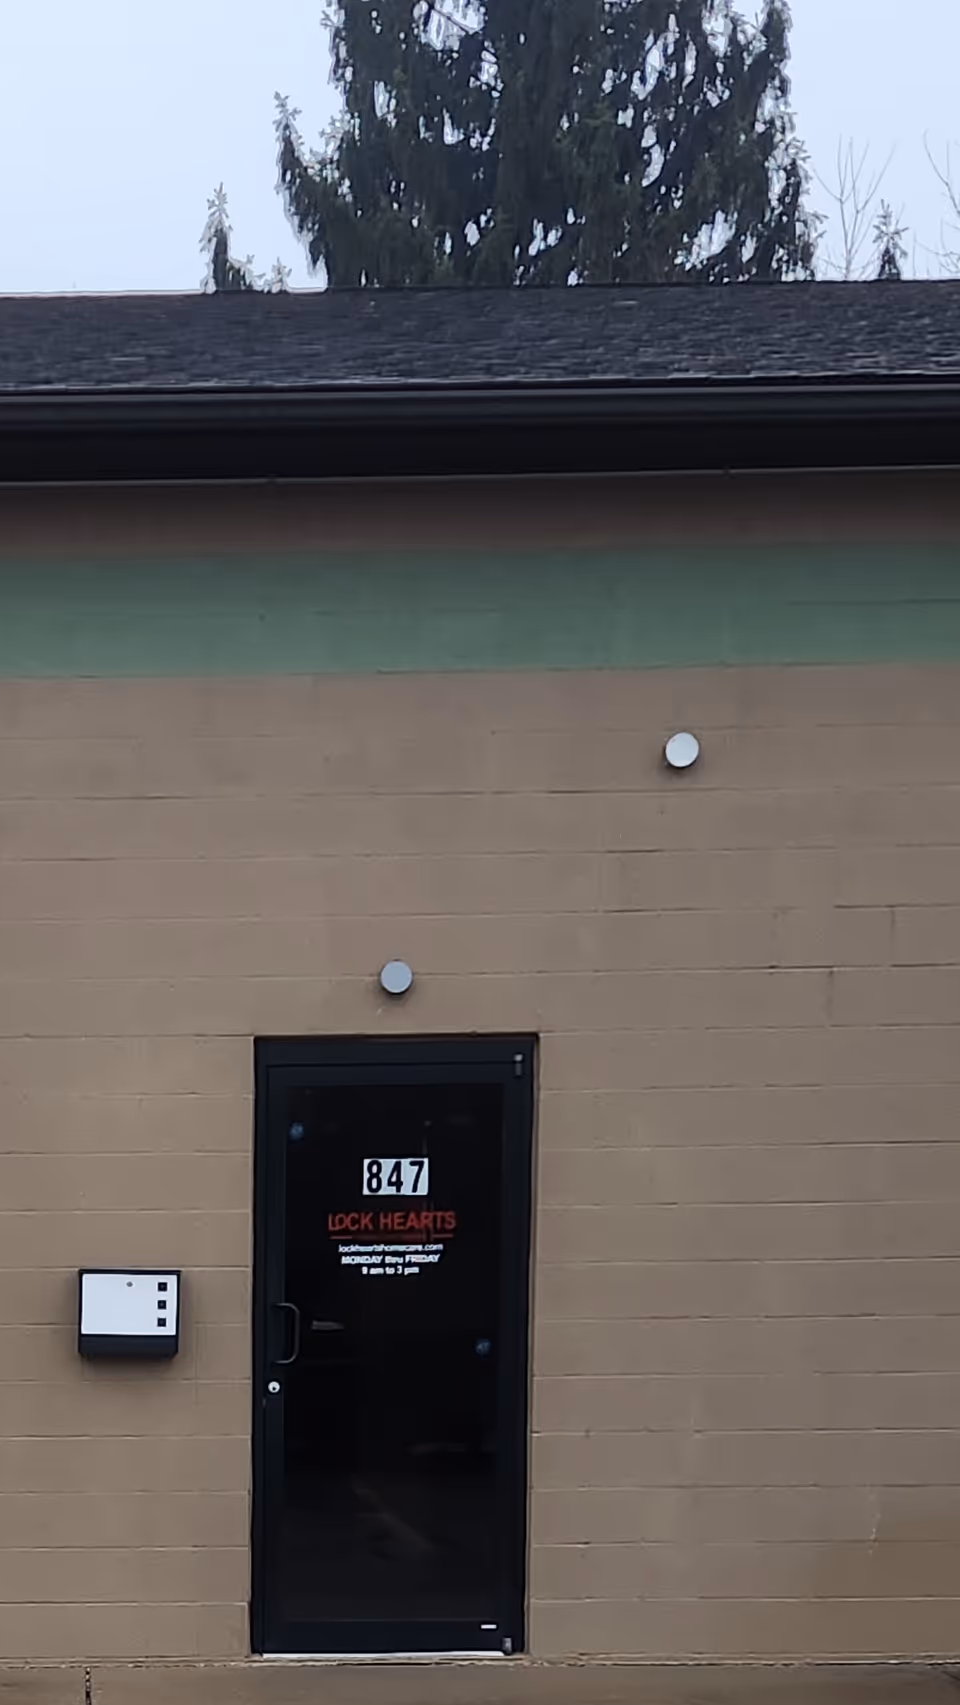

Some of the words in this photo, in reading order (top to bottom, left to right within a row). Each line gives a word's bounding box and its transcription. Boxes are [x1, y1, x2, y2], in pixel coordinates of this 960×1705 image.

[366, 1160, 425, 1193] 847
[328, 1212, 373, 1231] LOCK
[379, 1211, 456, 1230] HEARTS
[341, 1255, 383, 1264] MONDAY
[405, 1254, 440, 1263] FRIDAY
[385, 1266, 395, 1275] to
[396, 1265, 402, 1274] 3
